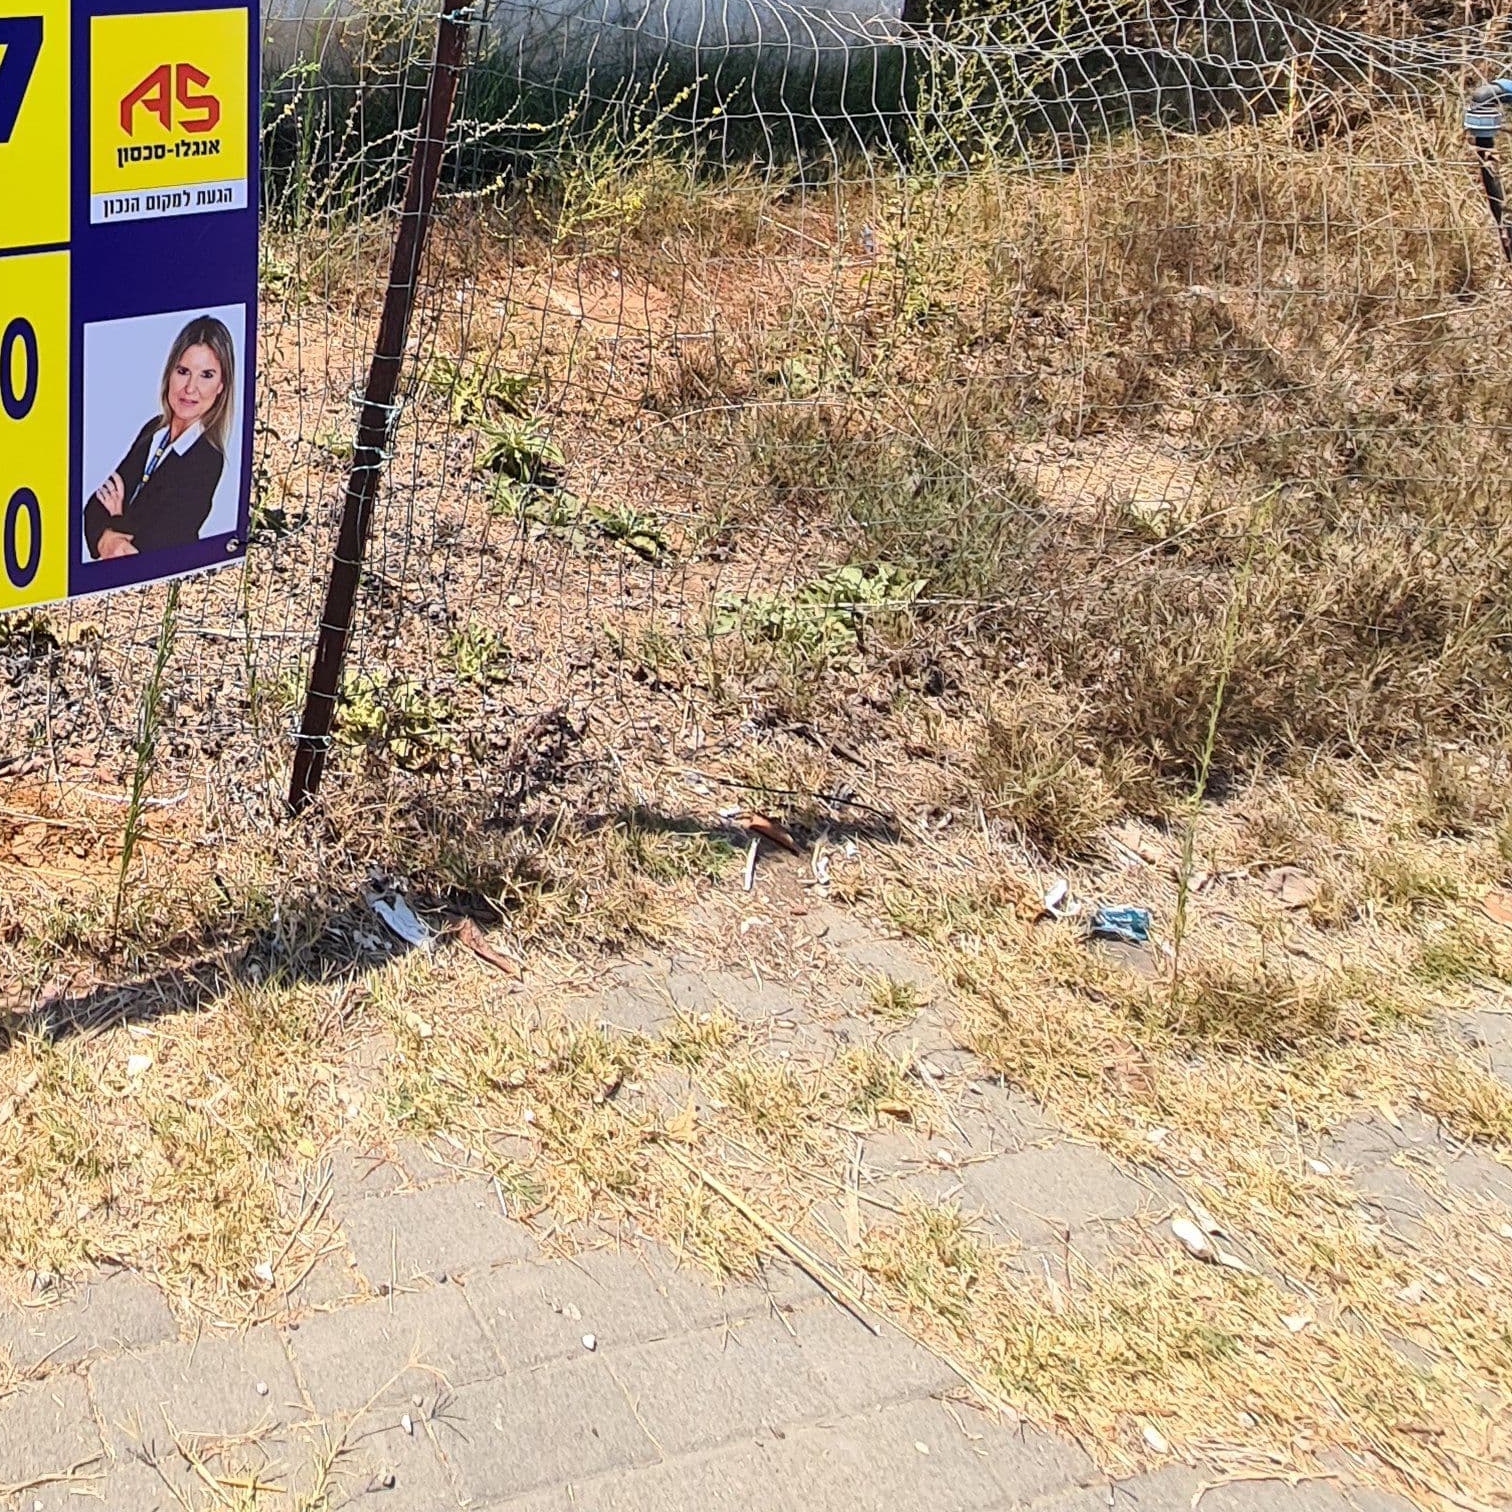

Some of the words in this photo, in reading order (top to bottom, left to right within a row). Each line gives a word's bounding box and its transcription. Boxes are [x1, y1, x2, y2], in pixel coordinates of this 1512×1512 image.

[120, 63, 220, 137] AS
[117, 139, 220, 169] אנגלו-סכסון
[103, 196, 140, 219] הנכון
[145, 189, 191, 213] למקום
[196, 187, 233, 206] הגעת
